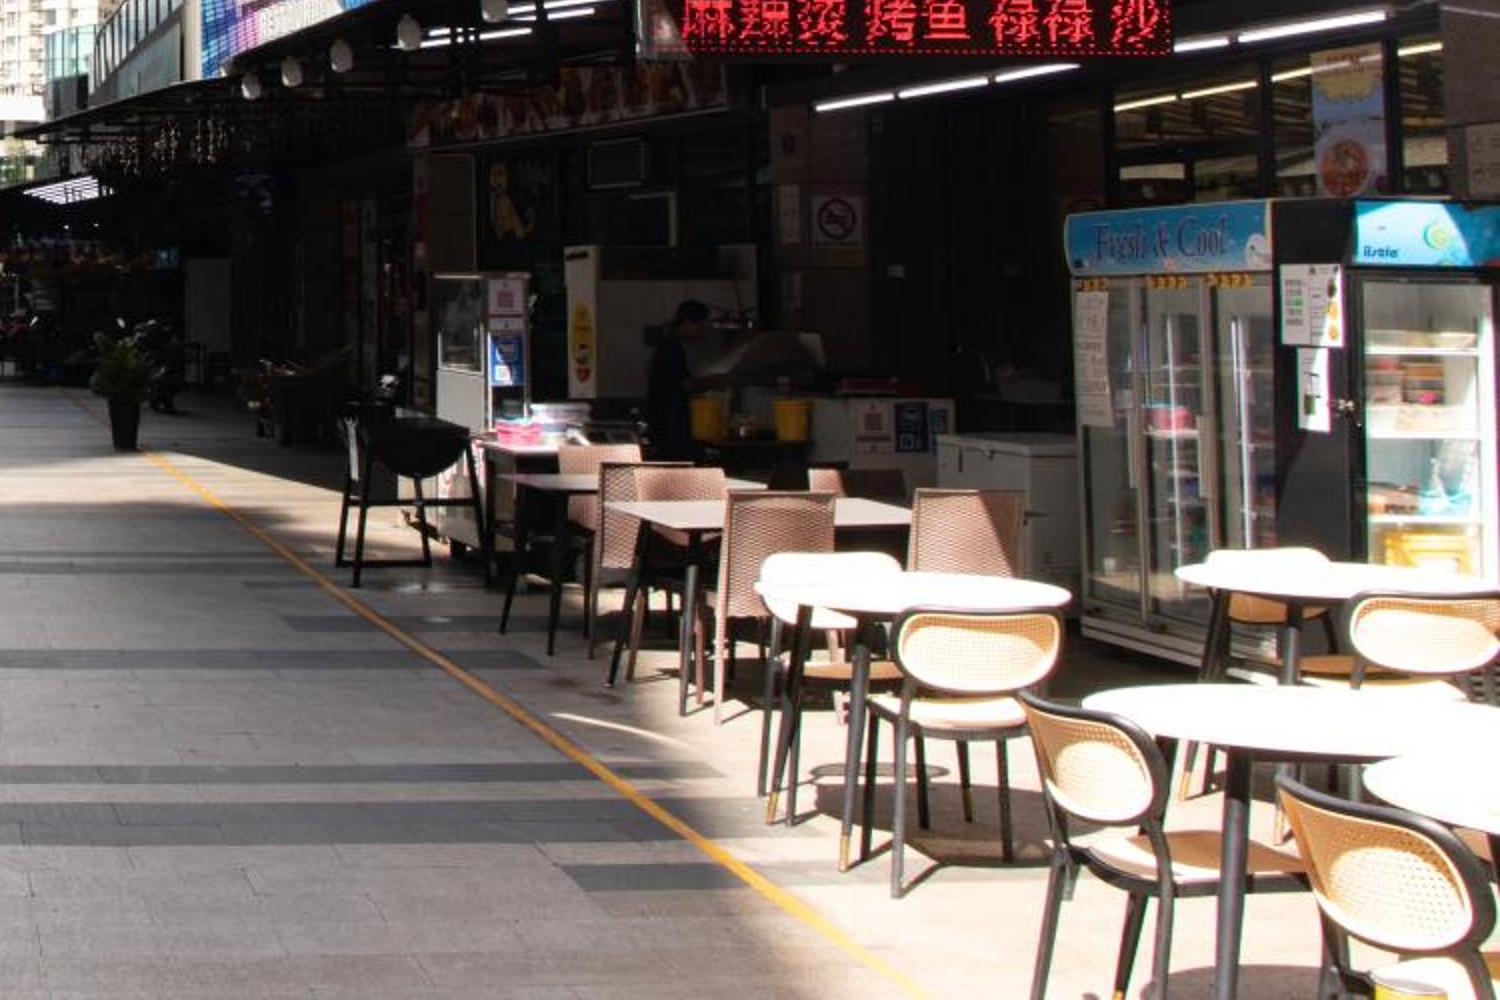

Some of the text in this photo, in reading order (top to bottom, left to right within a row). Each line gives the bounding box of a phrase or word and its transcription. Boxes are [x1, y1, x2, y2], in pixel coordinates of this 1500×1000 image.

[1092, 215, 1227, 262] Fresh & Cool
